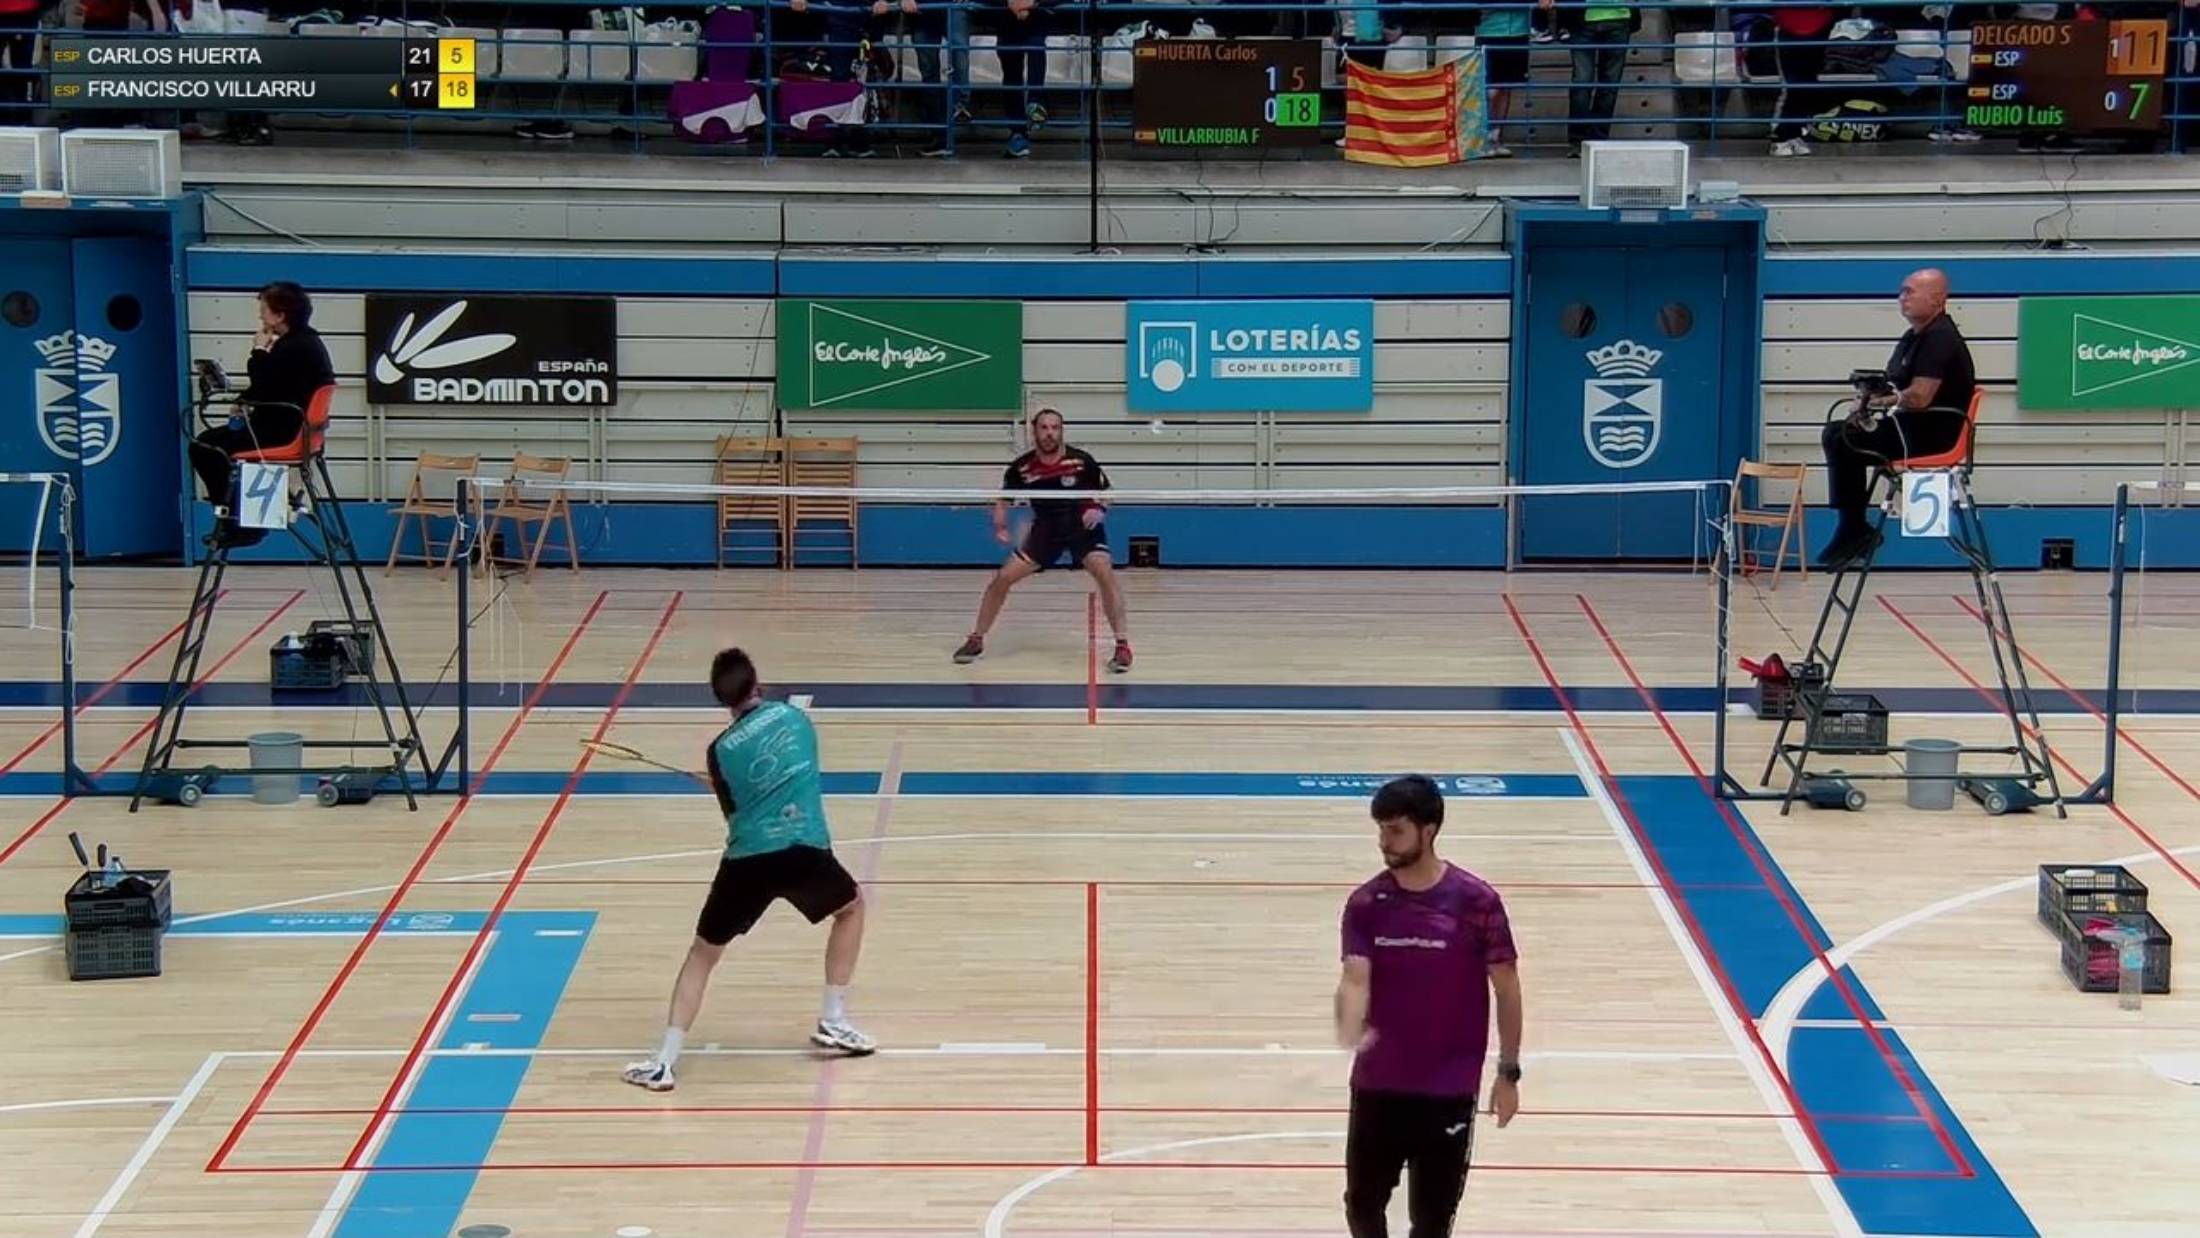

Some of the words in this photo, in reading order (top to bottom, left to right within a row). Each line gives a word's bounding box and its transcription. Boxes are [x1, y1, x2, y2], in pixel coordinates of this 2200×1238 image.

[1972, 25, 2055, 45] DELGADO
[2059, 25, 2073, 45] S
[1157, 44, 1212, 60] HUERTA
[1215, 44, 1257, 60] Carlos
[1994, 51, 2019, 66] ESP
[2110, 38, 2119, 58] 1
[2124, 30, 2160, 66] 11
[1265, 66, 1276, 91] 1
[1292, 67, 1304, 91] 5
[1992, 84, 2017, 100] ESP
[2104, 91, 2117, 110] 0
[2128, 83, 2150, 120] 7
[1264, 97, 1276, 123] 0
[1285, 98, 1312, 122] 18
[1966, 106, 2022, 125] RUBIO
[2027, 105, 2064, 125] Luis
[1157, 128, 1248, 144] VILLARRUBIA
[1252, 128, 1261, 143] F
[1210, 323, 1361, 352] LOTERÍAS
[815, 341, 834, 361] El
[836, 342, 880, 361] Corte
[881, 337, 946, 369] Inglés
[2077, 344, 2093, 360] El
[2094, 344, 2130, 360] Corte
[2132, 340, 2187, 365] Inglés
[1227, 362, 1257, 373] CON
[1262, 362, 1278, 373] EL
[1281, 362, 1345, 373] DEPORTE
[413, 377, 609, 403] BADMINTON
[245, 466, 285, 525] 4
[1904, 475, 1940, 535] 5
